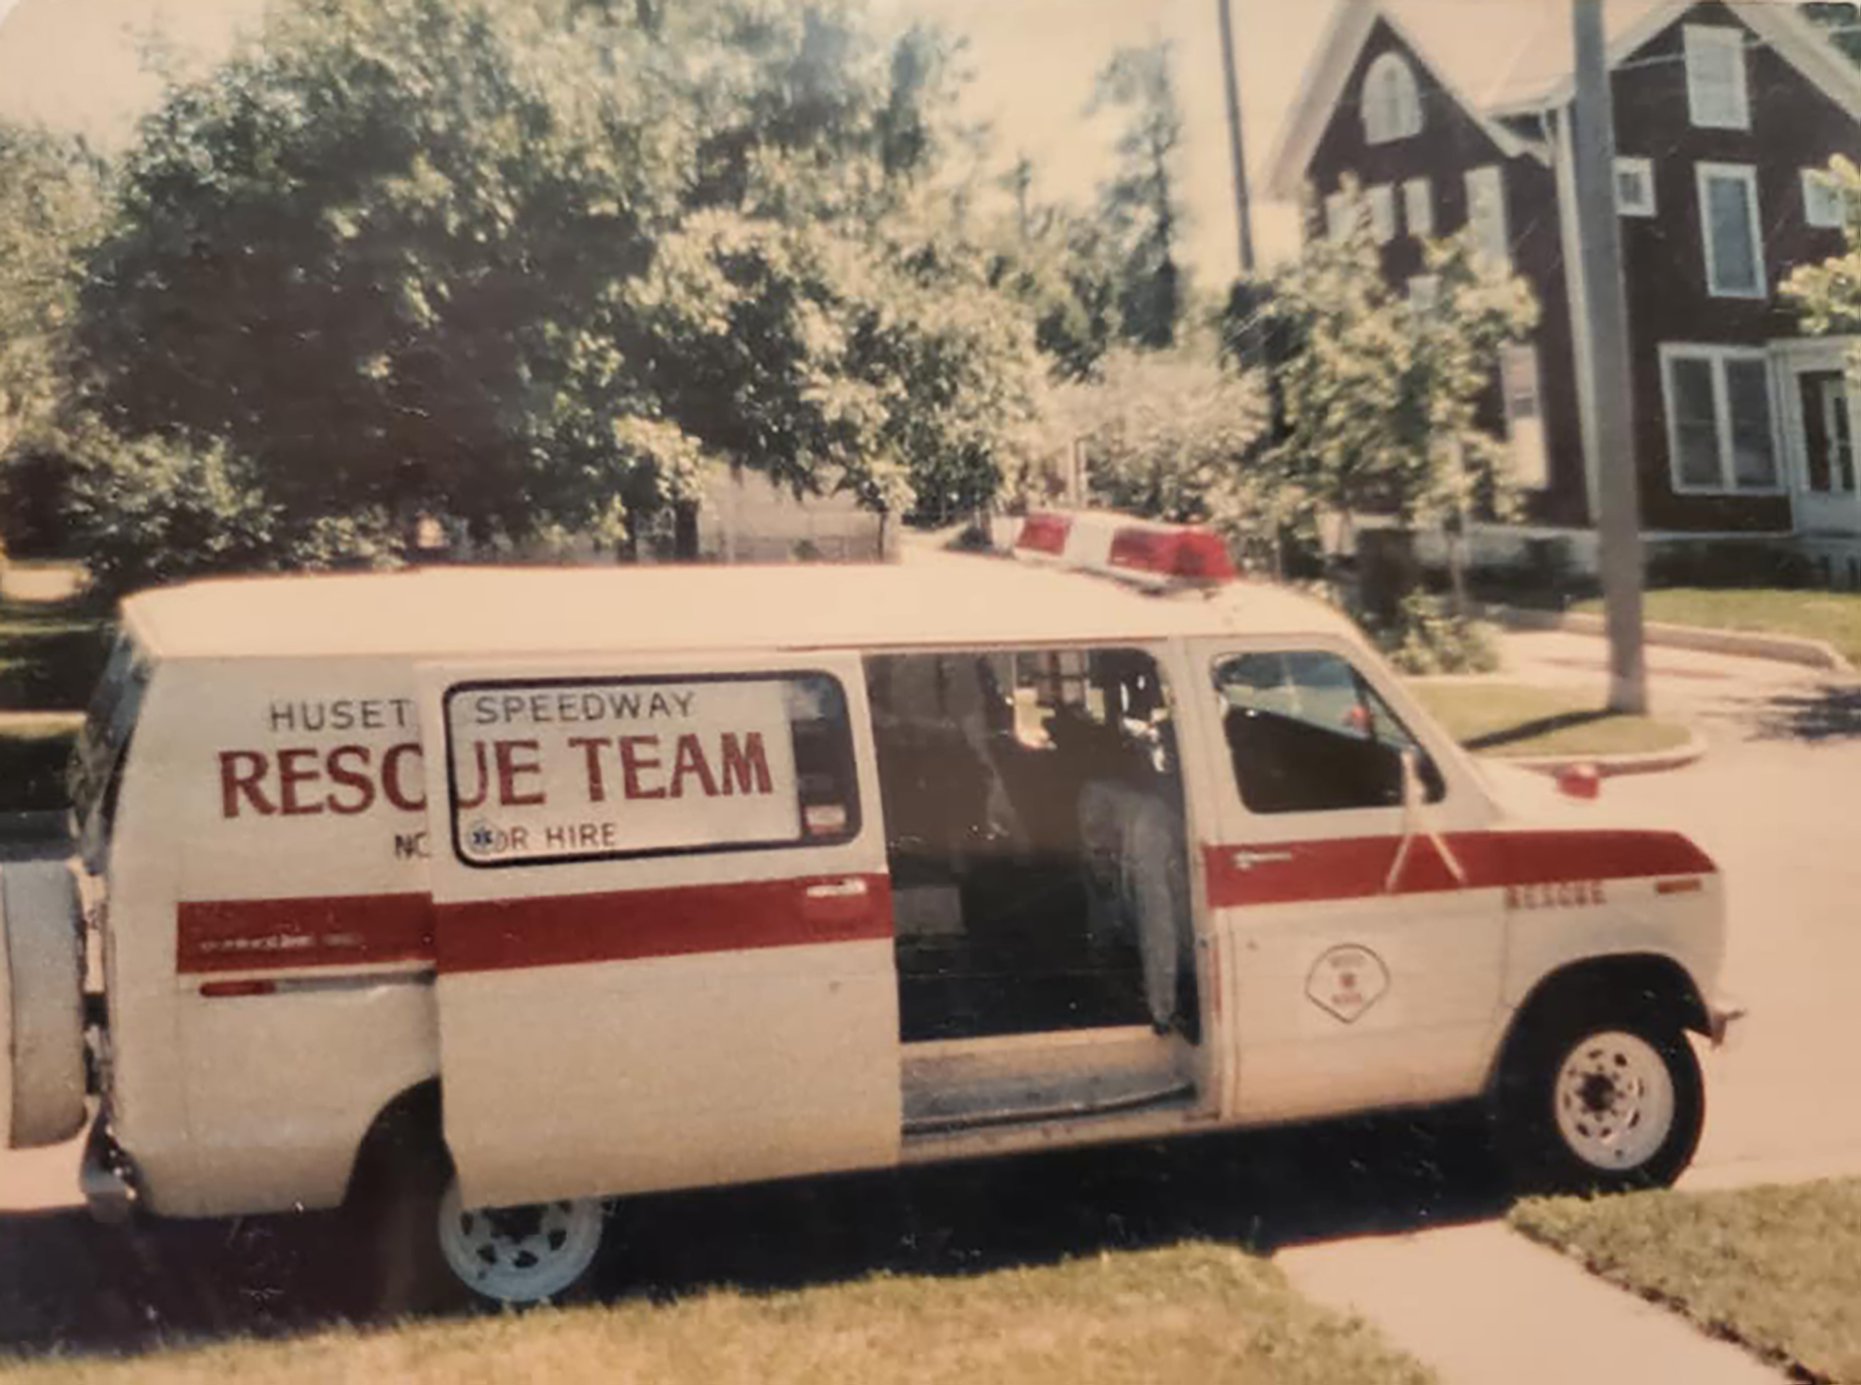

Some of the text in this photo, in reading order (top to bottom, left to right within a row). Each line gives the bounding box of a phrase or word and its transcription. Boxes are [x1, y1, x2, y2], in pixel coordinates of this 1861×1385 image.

[474, 691, 696, 725] SPEEDWAY
[567, 731, 774, 803] TEAM
[545, 822, 617, 849] HIRE
